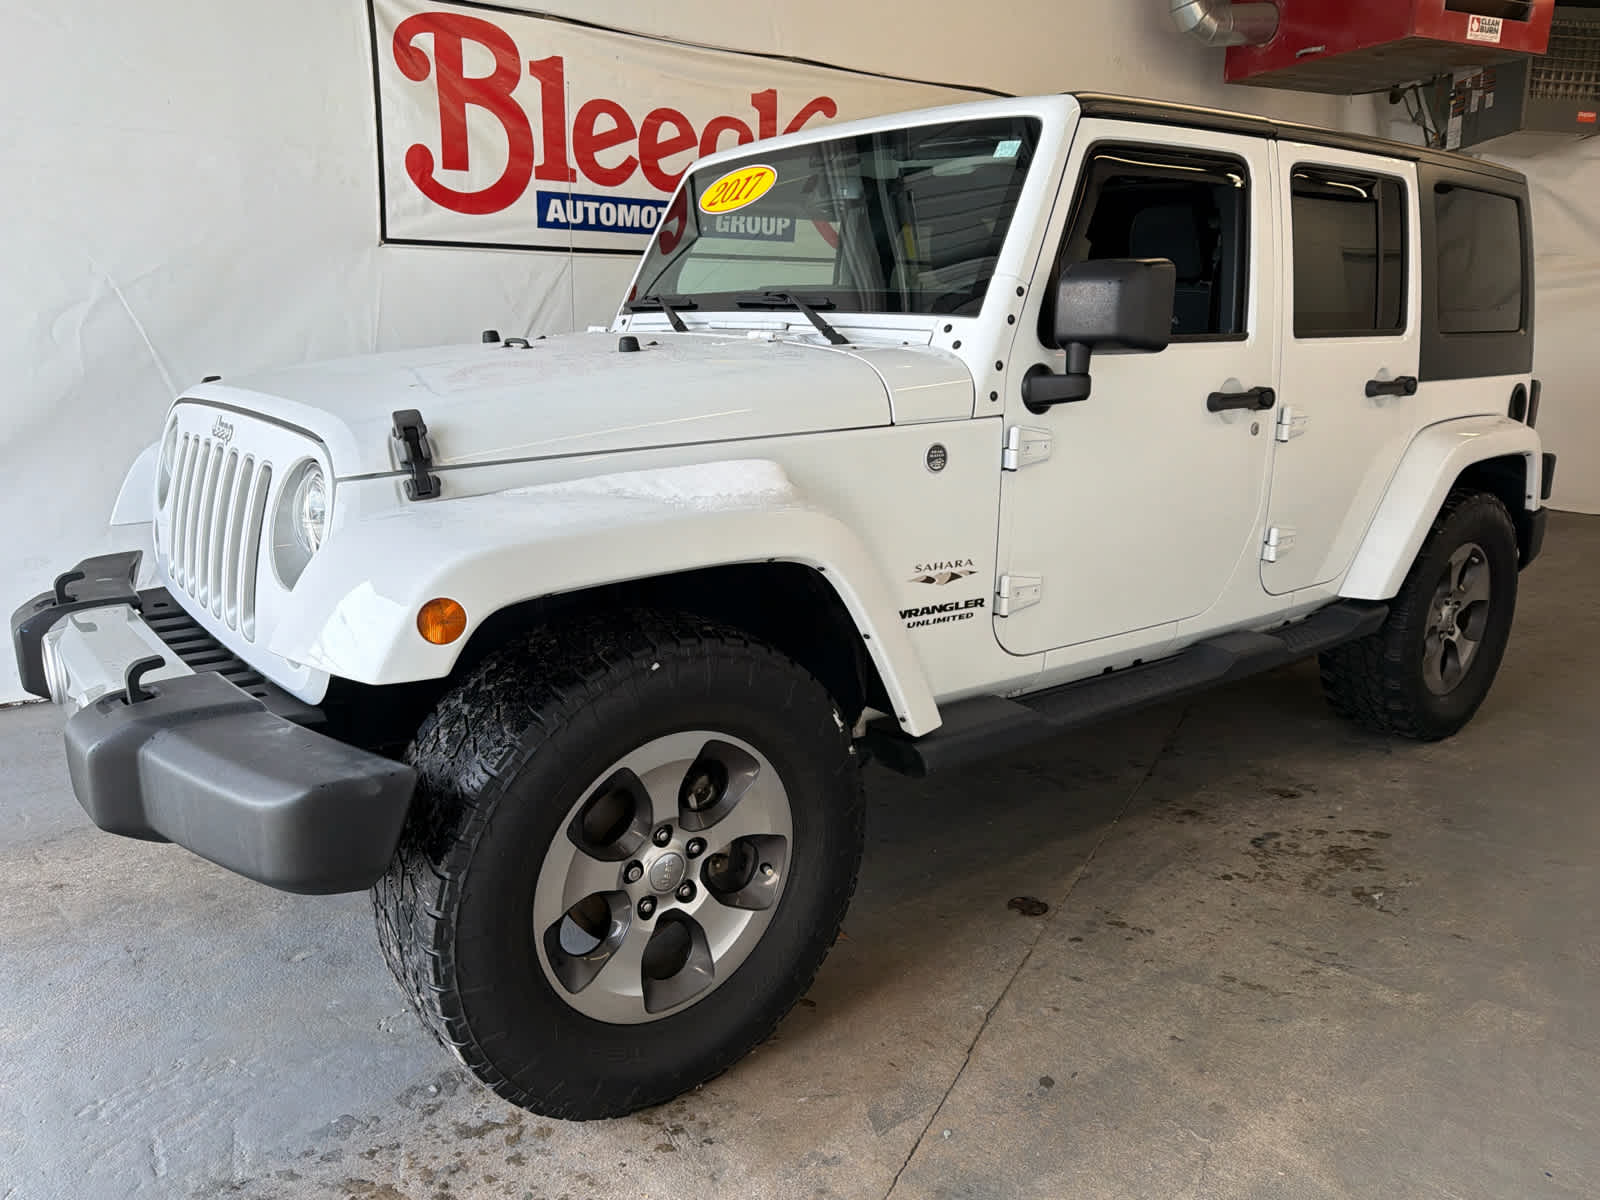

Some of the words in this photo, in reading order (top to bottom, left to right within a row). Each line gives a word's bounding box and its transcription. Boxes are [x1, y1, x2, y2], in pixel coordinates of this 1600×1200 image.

[1480, 26, 1498, 34] BURN
[1481, 18, 1500, 26] CLEAN
[707, 172, 766, 207] 2017
[715, 216, 791, 235] GROUP
[914, 558, 974, 573] SAHARA
[907, 612, 974, 629] UNLIMITED
